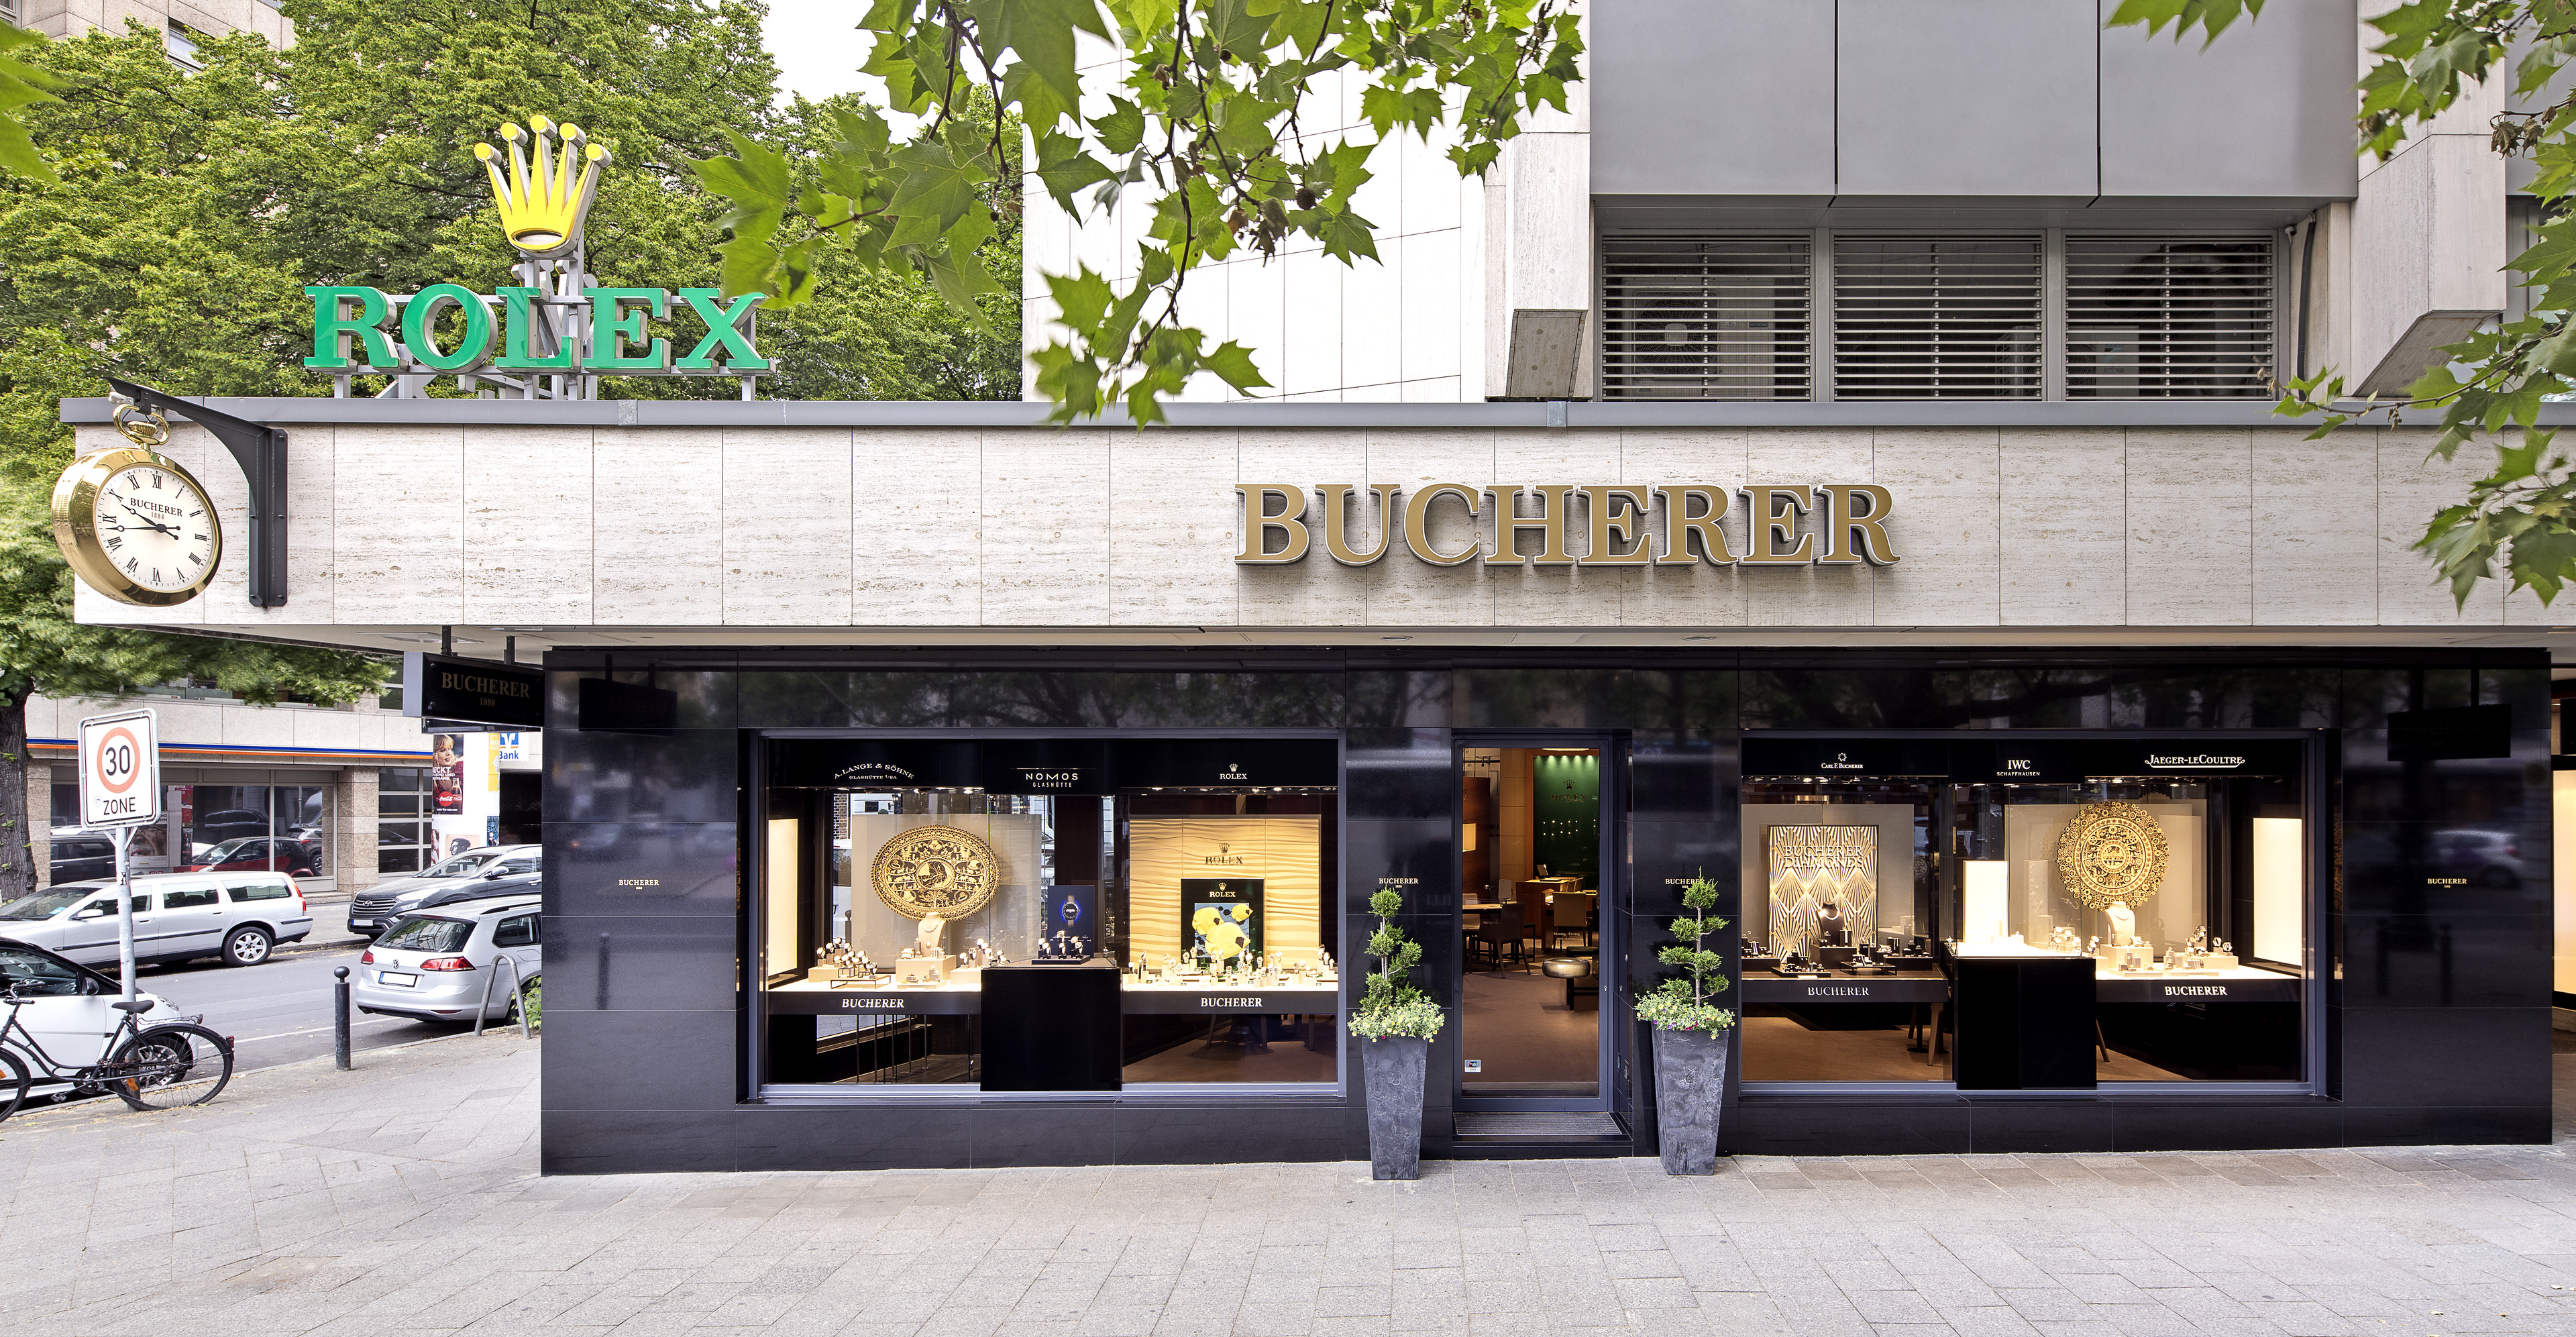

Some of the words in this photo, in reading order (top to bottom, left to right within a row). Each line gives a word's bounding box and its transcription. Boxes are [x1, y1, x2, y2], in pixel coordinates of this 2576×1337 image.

[304, 283, 775, 374] ROLEX
[130, 498, 182, 517] BUCHERER
[151, 511, 164, 520] 1888
[1234, 482, 1902, 568] BUCHERER
[441, 672, 530, 698] BUCHERER
[480, 698, 495, 706] 1888
[499, 750, 519, 759] Bank
[106, 745, 130, 776] 30
[2008, 760, 2031, 769] IWC
[885, 764, 914, 779] SÖHNE
[103, 797, 136, 815] ZONE
[1784, 845, 1863, 857] BUCHERER
[1784, 856, 1864, 867] DIAMONDS
[1808, 987, 1869, 996] BUCHERER
[2165, 986, 2228, 996] BUCHERER
[842, 998, 904, 1008] BUCHERER
[1201, 998, 1263, 1007] BUCHERER
